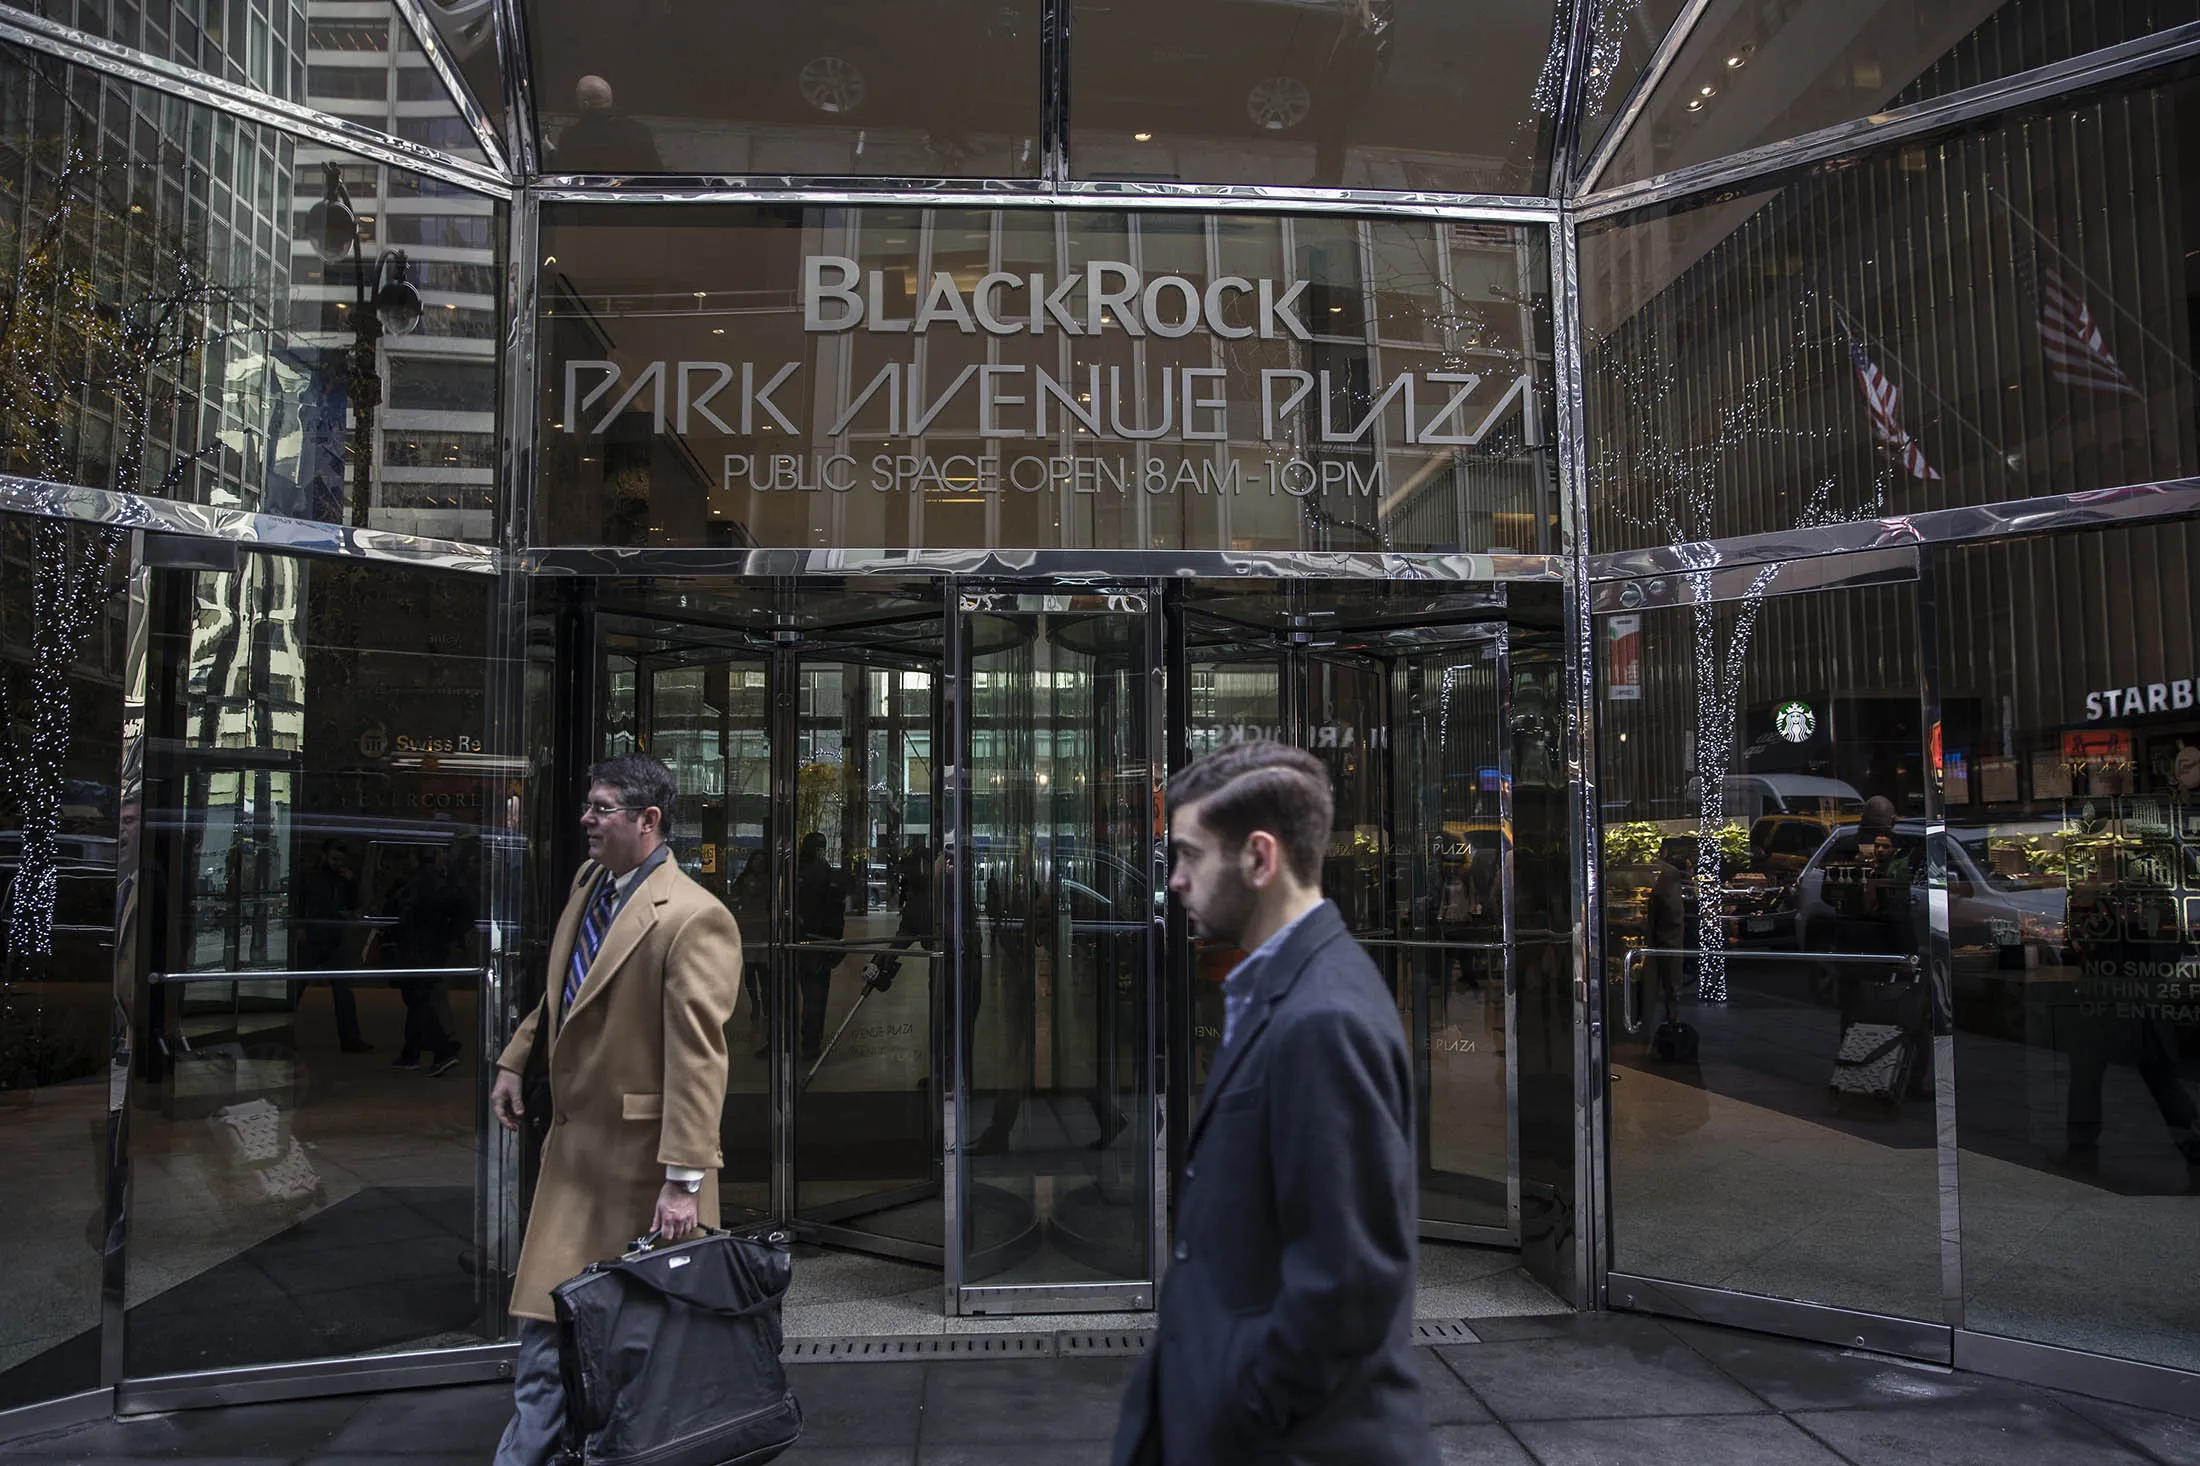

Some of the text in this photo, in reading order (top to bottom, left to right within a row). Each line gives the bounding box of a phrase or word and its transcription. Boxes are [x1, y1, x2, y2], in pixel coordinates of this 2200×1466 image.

[563, 360, 1535, 446] PARK AVENUE PLAZA
[724, 453, 858, 492] PUBLIC
[871, 454, 999, 493] SPACE
[1009, 455, 1126, 493] OPEN
[2086, 677, 2200, 721] STARB
[458, 735, 481, 752] Re
[1432, 842, 1472, 856] PLAZA
[2085, 960, 2200, 979] NO SMOKI
[2155, 983, 2181, 1000] 25
[1436, 1038, 1475, 1053] PLAZA
